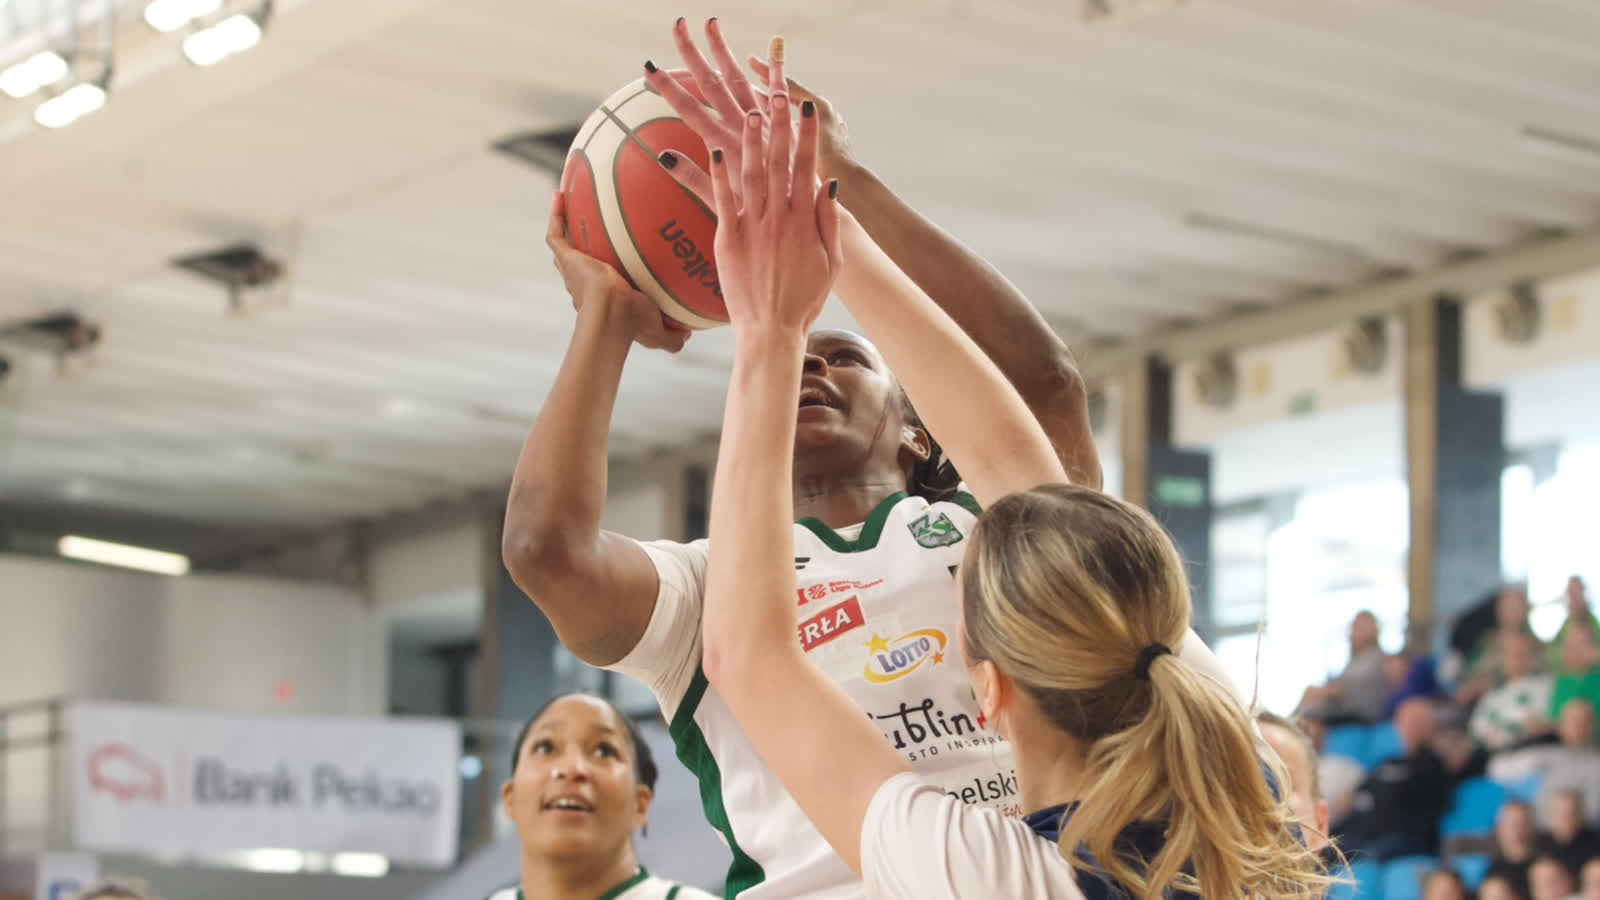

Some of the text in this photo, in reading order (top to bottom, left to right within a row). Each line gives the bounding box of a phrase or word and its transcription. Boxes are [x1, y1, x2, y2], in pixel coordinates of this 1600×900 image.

[877, 637, 931, 673] LOTTO
[192, 758, 443, 817] Bank Pekao
